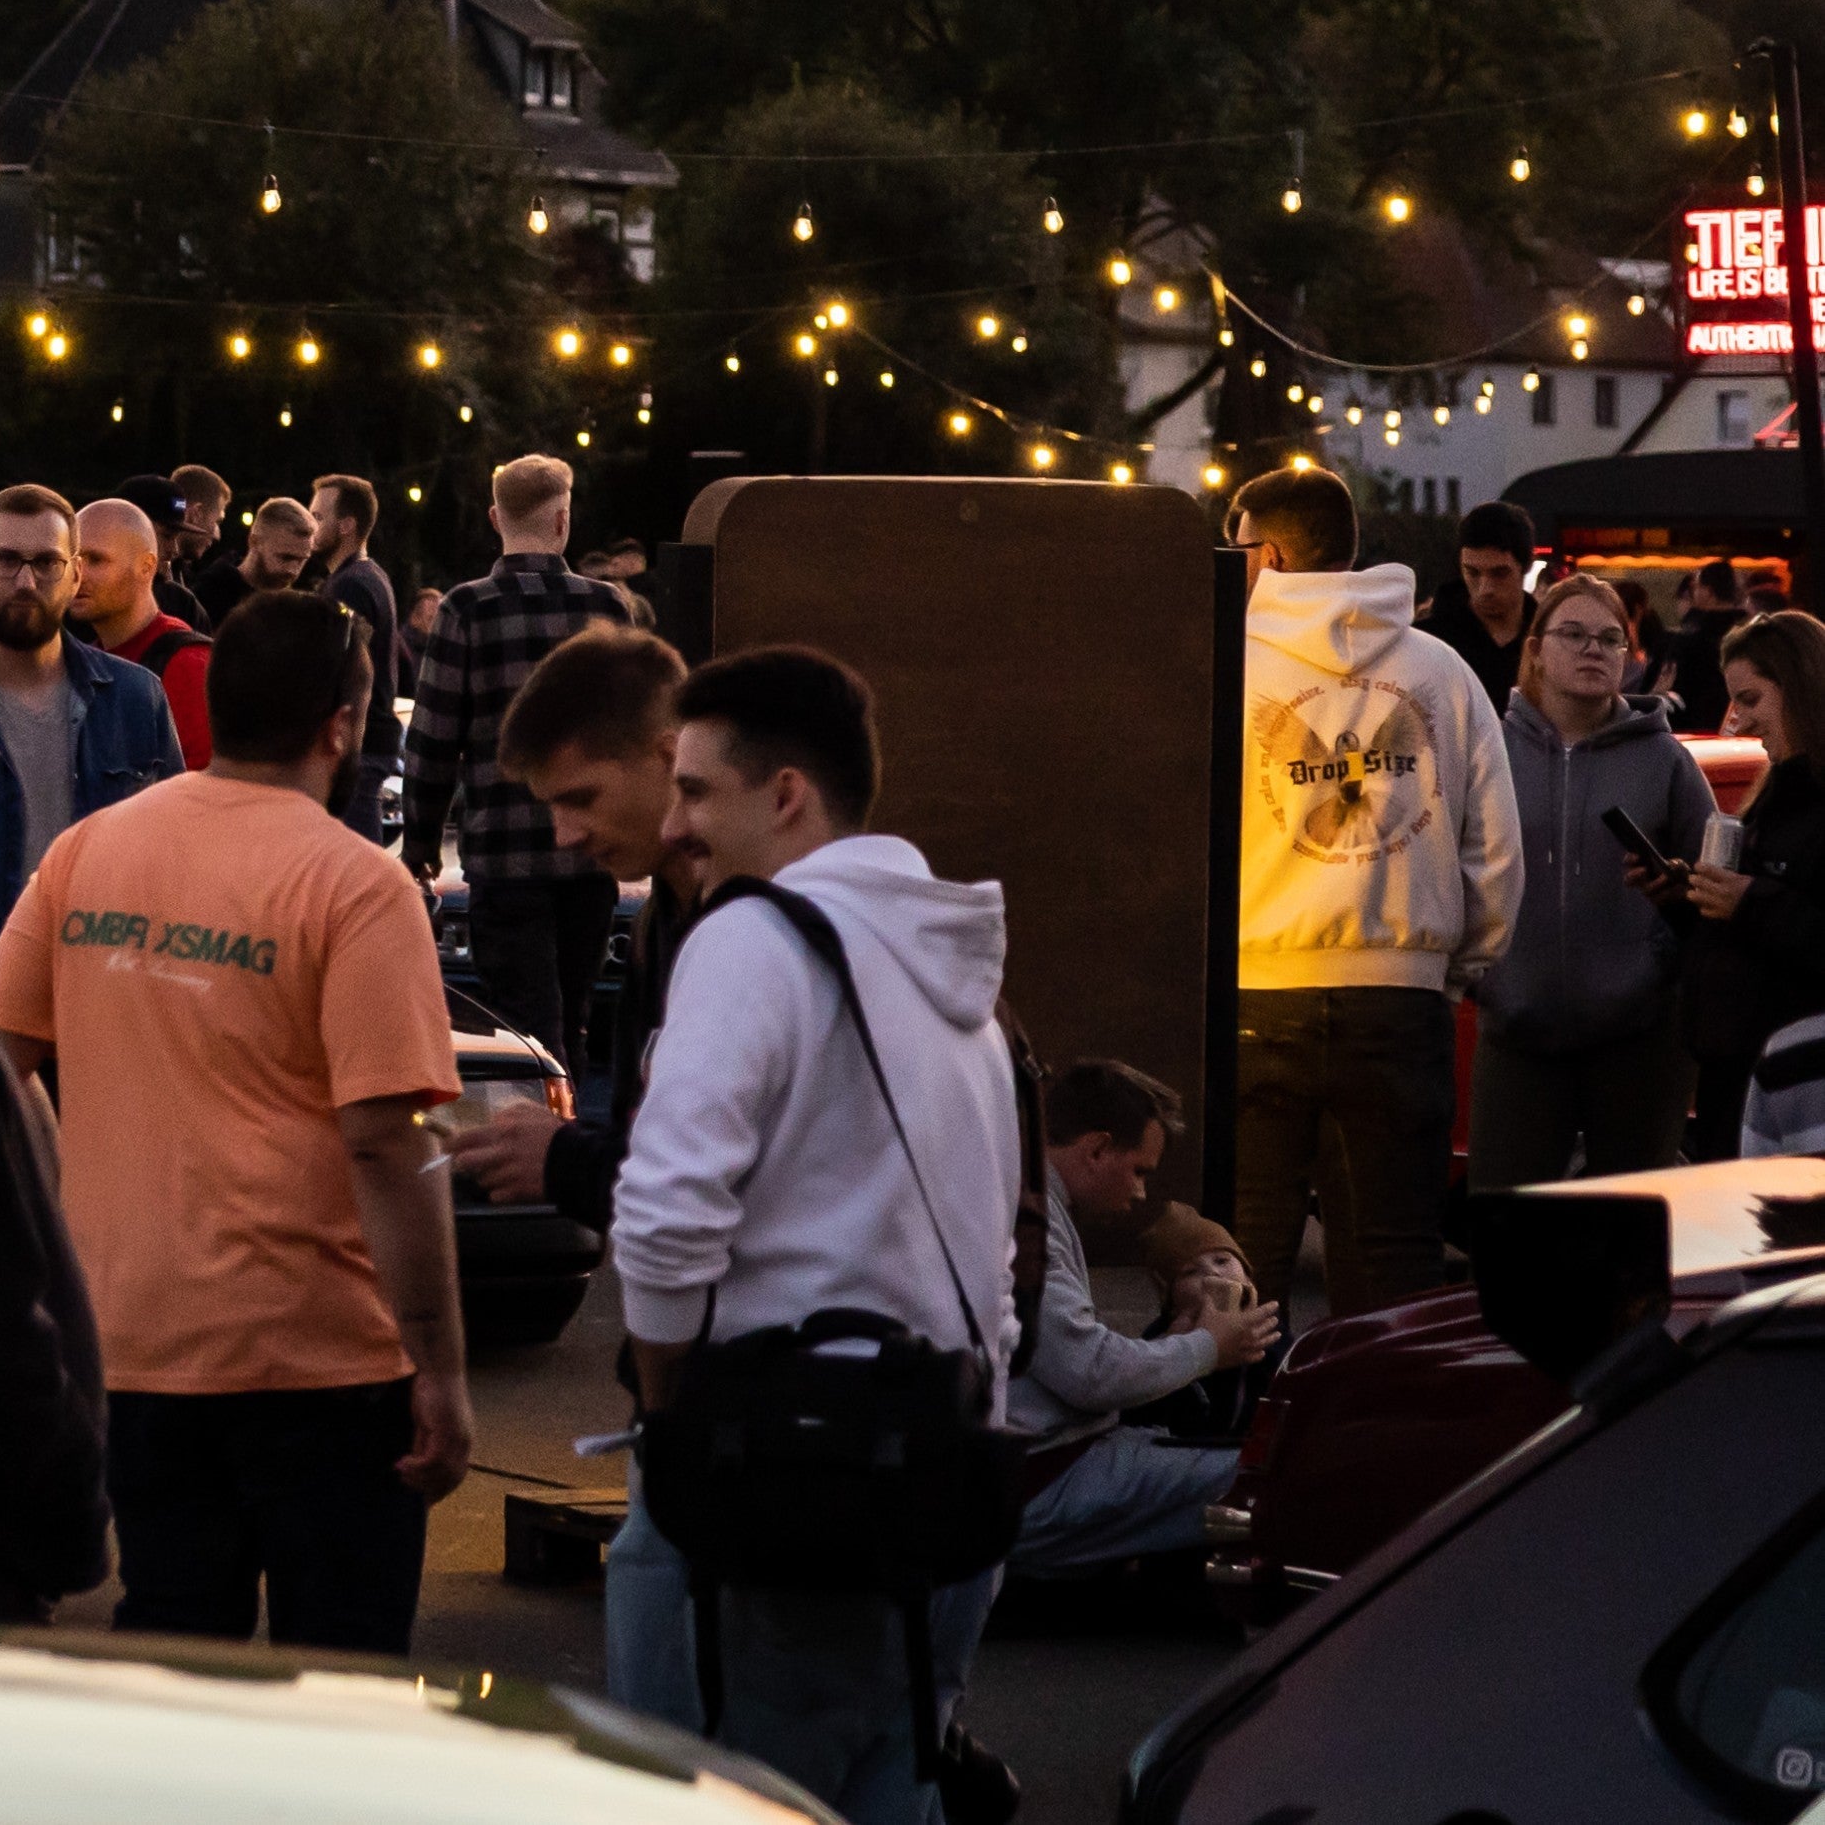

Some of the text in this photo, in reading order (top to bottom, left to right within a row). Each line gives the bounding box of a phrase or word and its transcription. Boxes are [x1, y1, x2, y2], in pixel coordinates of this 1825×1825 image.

[1688, 269, 1738, 300] LIFE
[1737, 267, 1763, 298] IS
[1286, 749, 1417, 786] Drop Size
